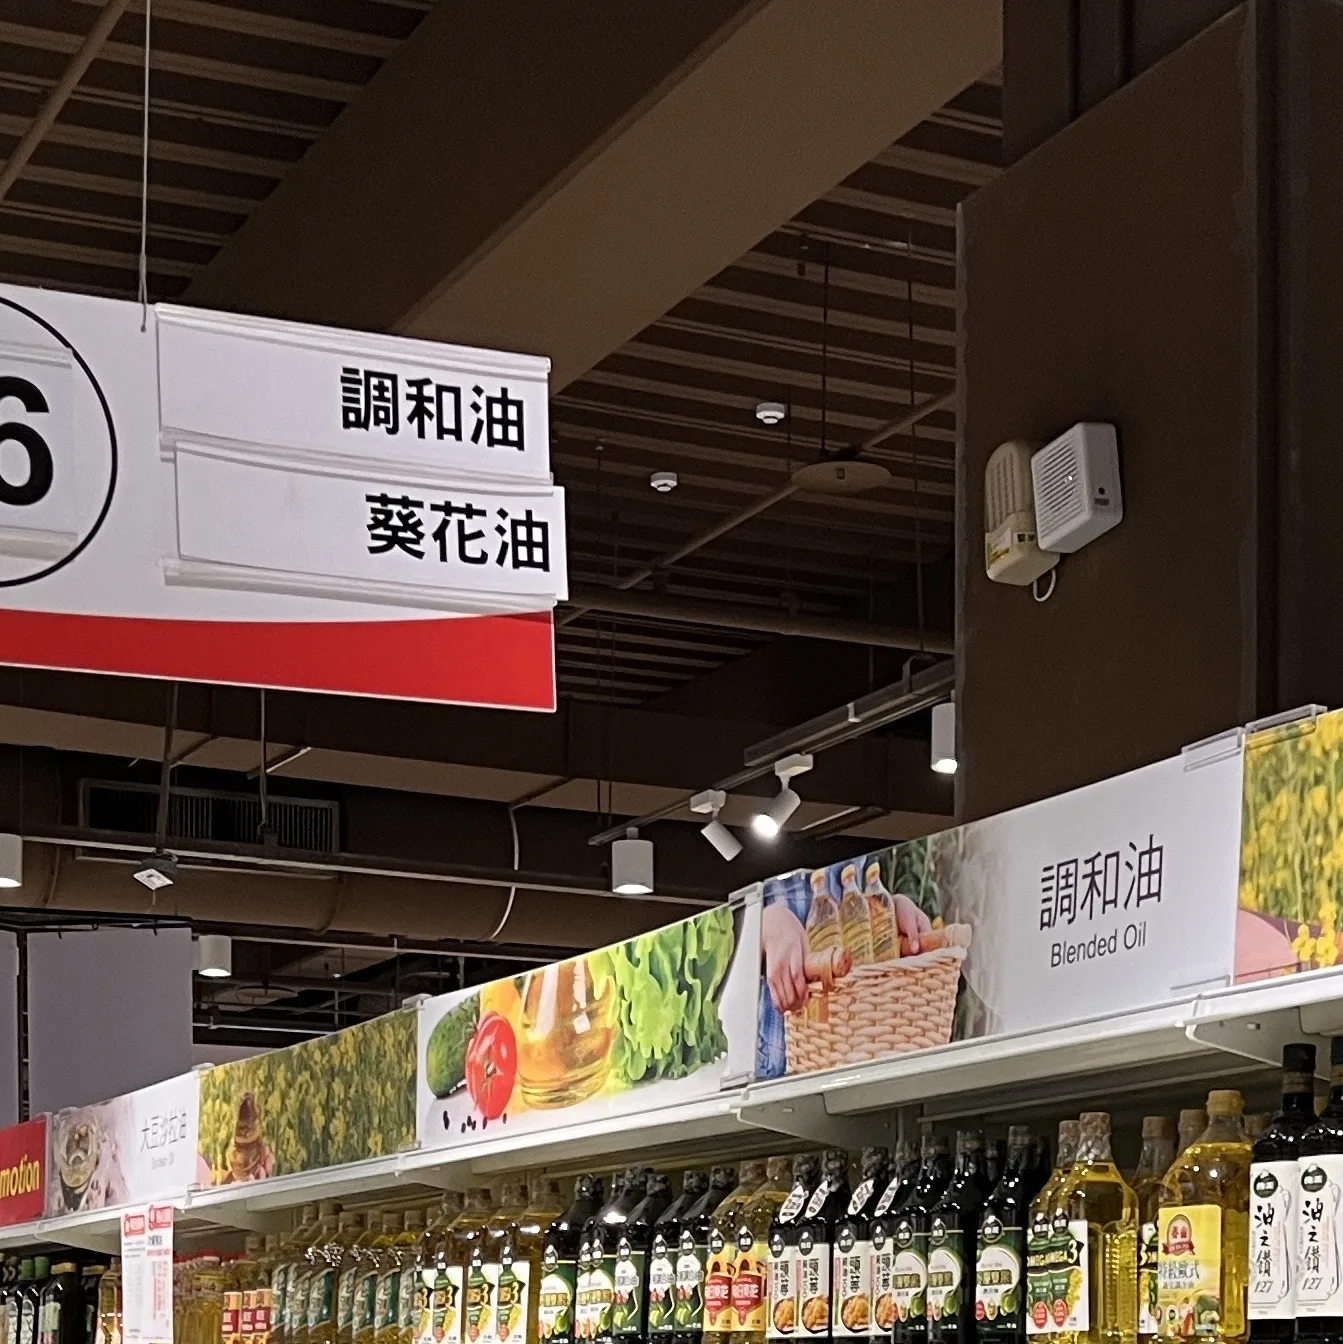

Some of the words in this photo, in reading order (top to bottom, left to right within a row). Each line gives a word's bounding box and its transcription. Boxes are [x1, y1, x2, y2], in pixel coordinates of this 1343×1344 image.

[339, 365, 526, 452] 調和油
[366, 493, 552, 572] 葵花油
[1040, 834, 1164, 932] 調和油
[1051, 931, 1118, 967] Blended
[1123, 922, 1147, 954] Oil
